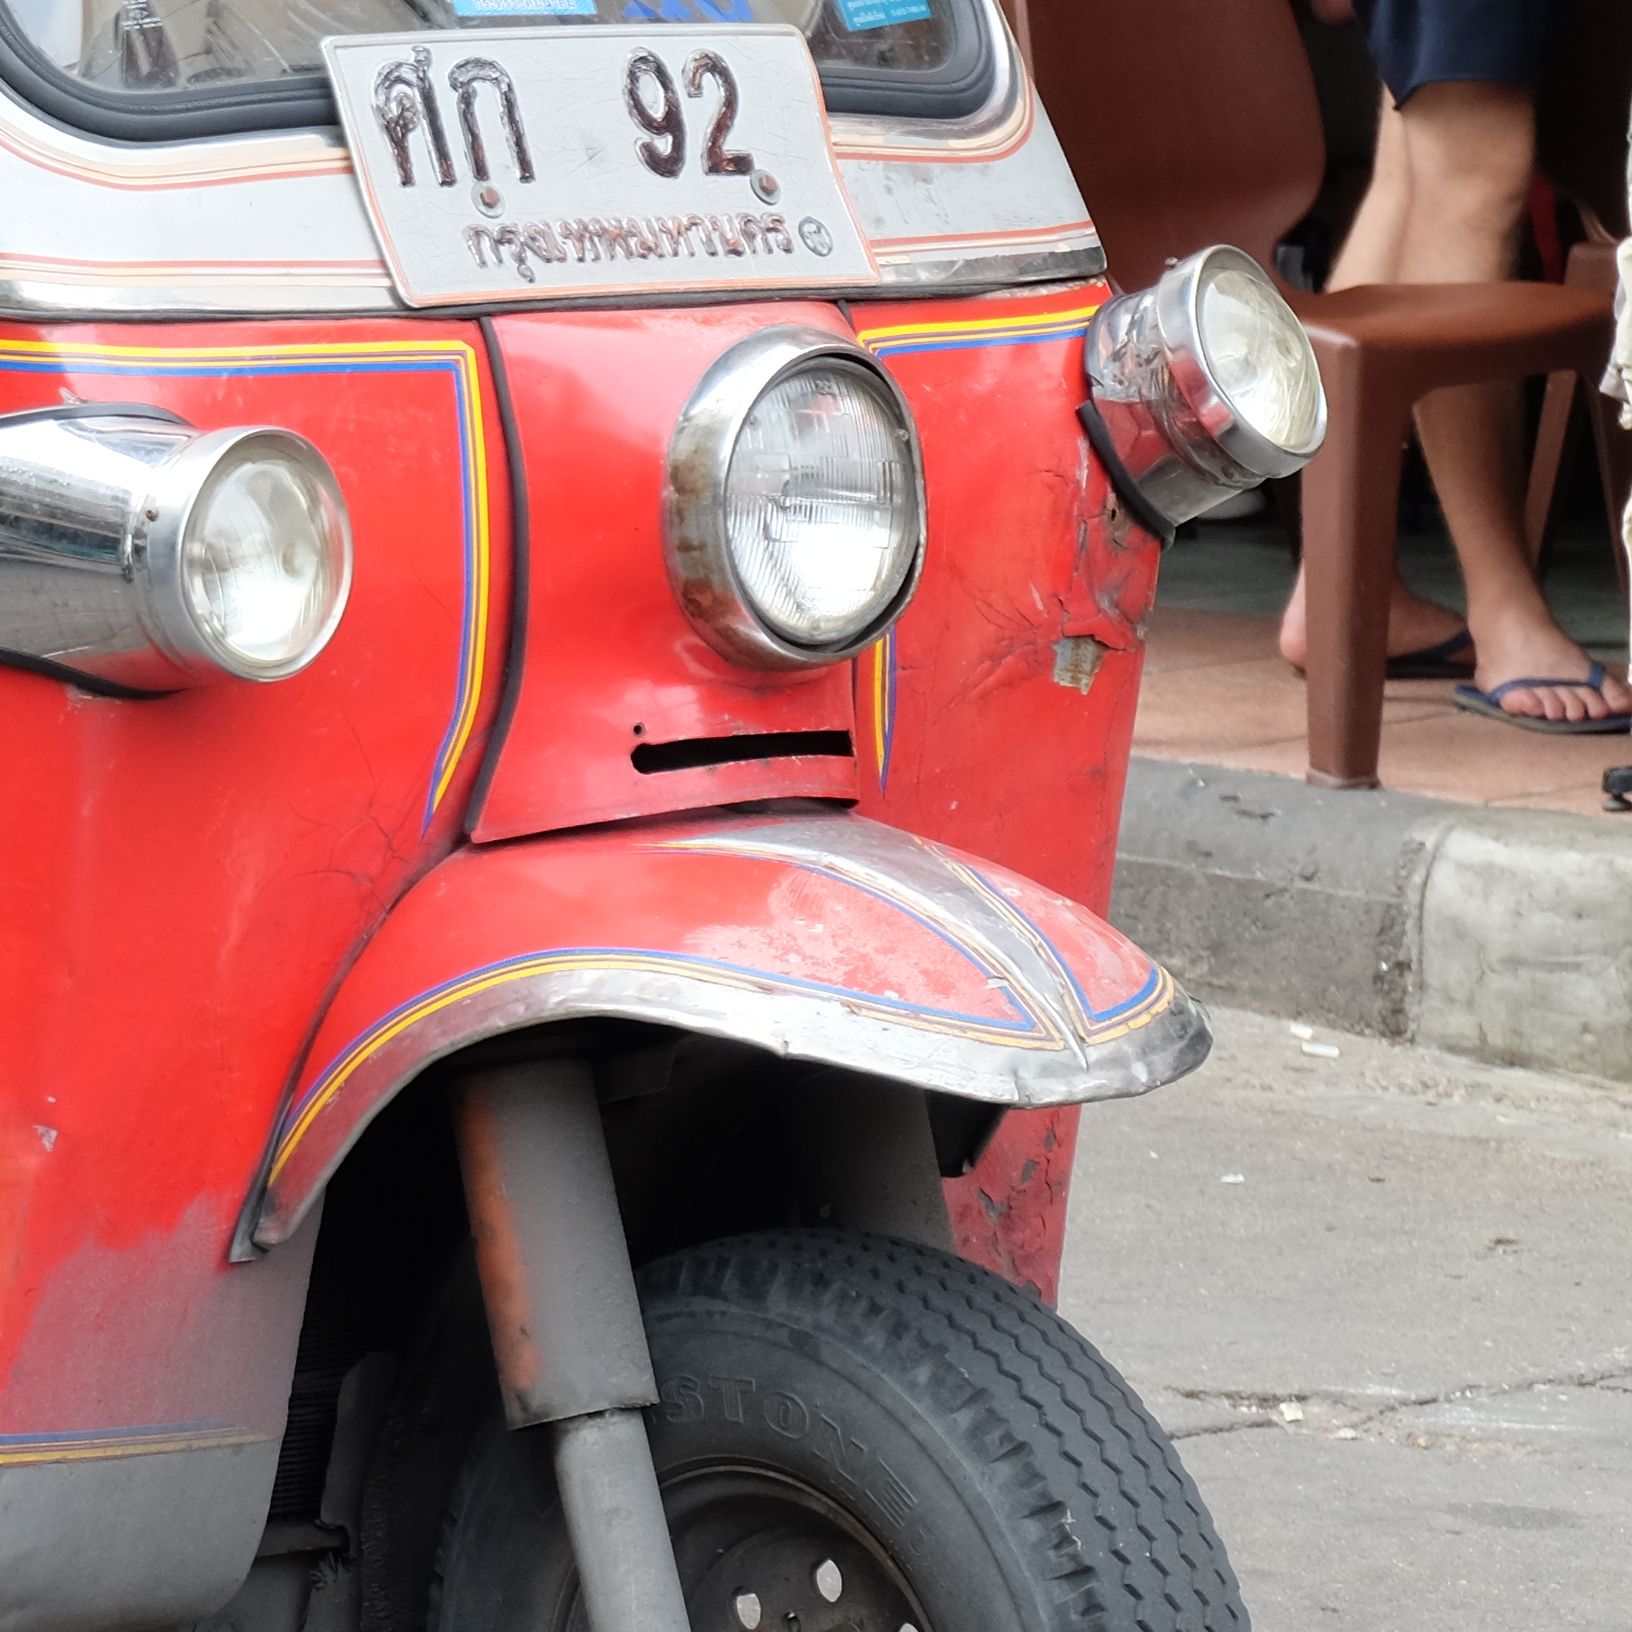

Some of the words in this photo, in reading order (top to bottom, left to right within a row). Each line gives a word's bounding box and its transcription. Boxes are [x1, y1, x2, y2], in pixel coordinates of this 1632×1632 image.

[622, 45, 757, 182] 92
[464, 210, 794, 283] กรุงเทพมหานคร
